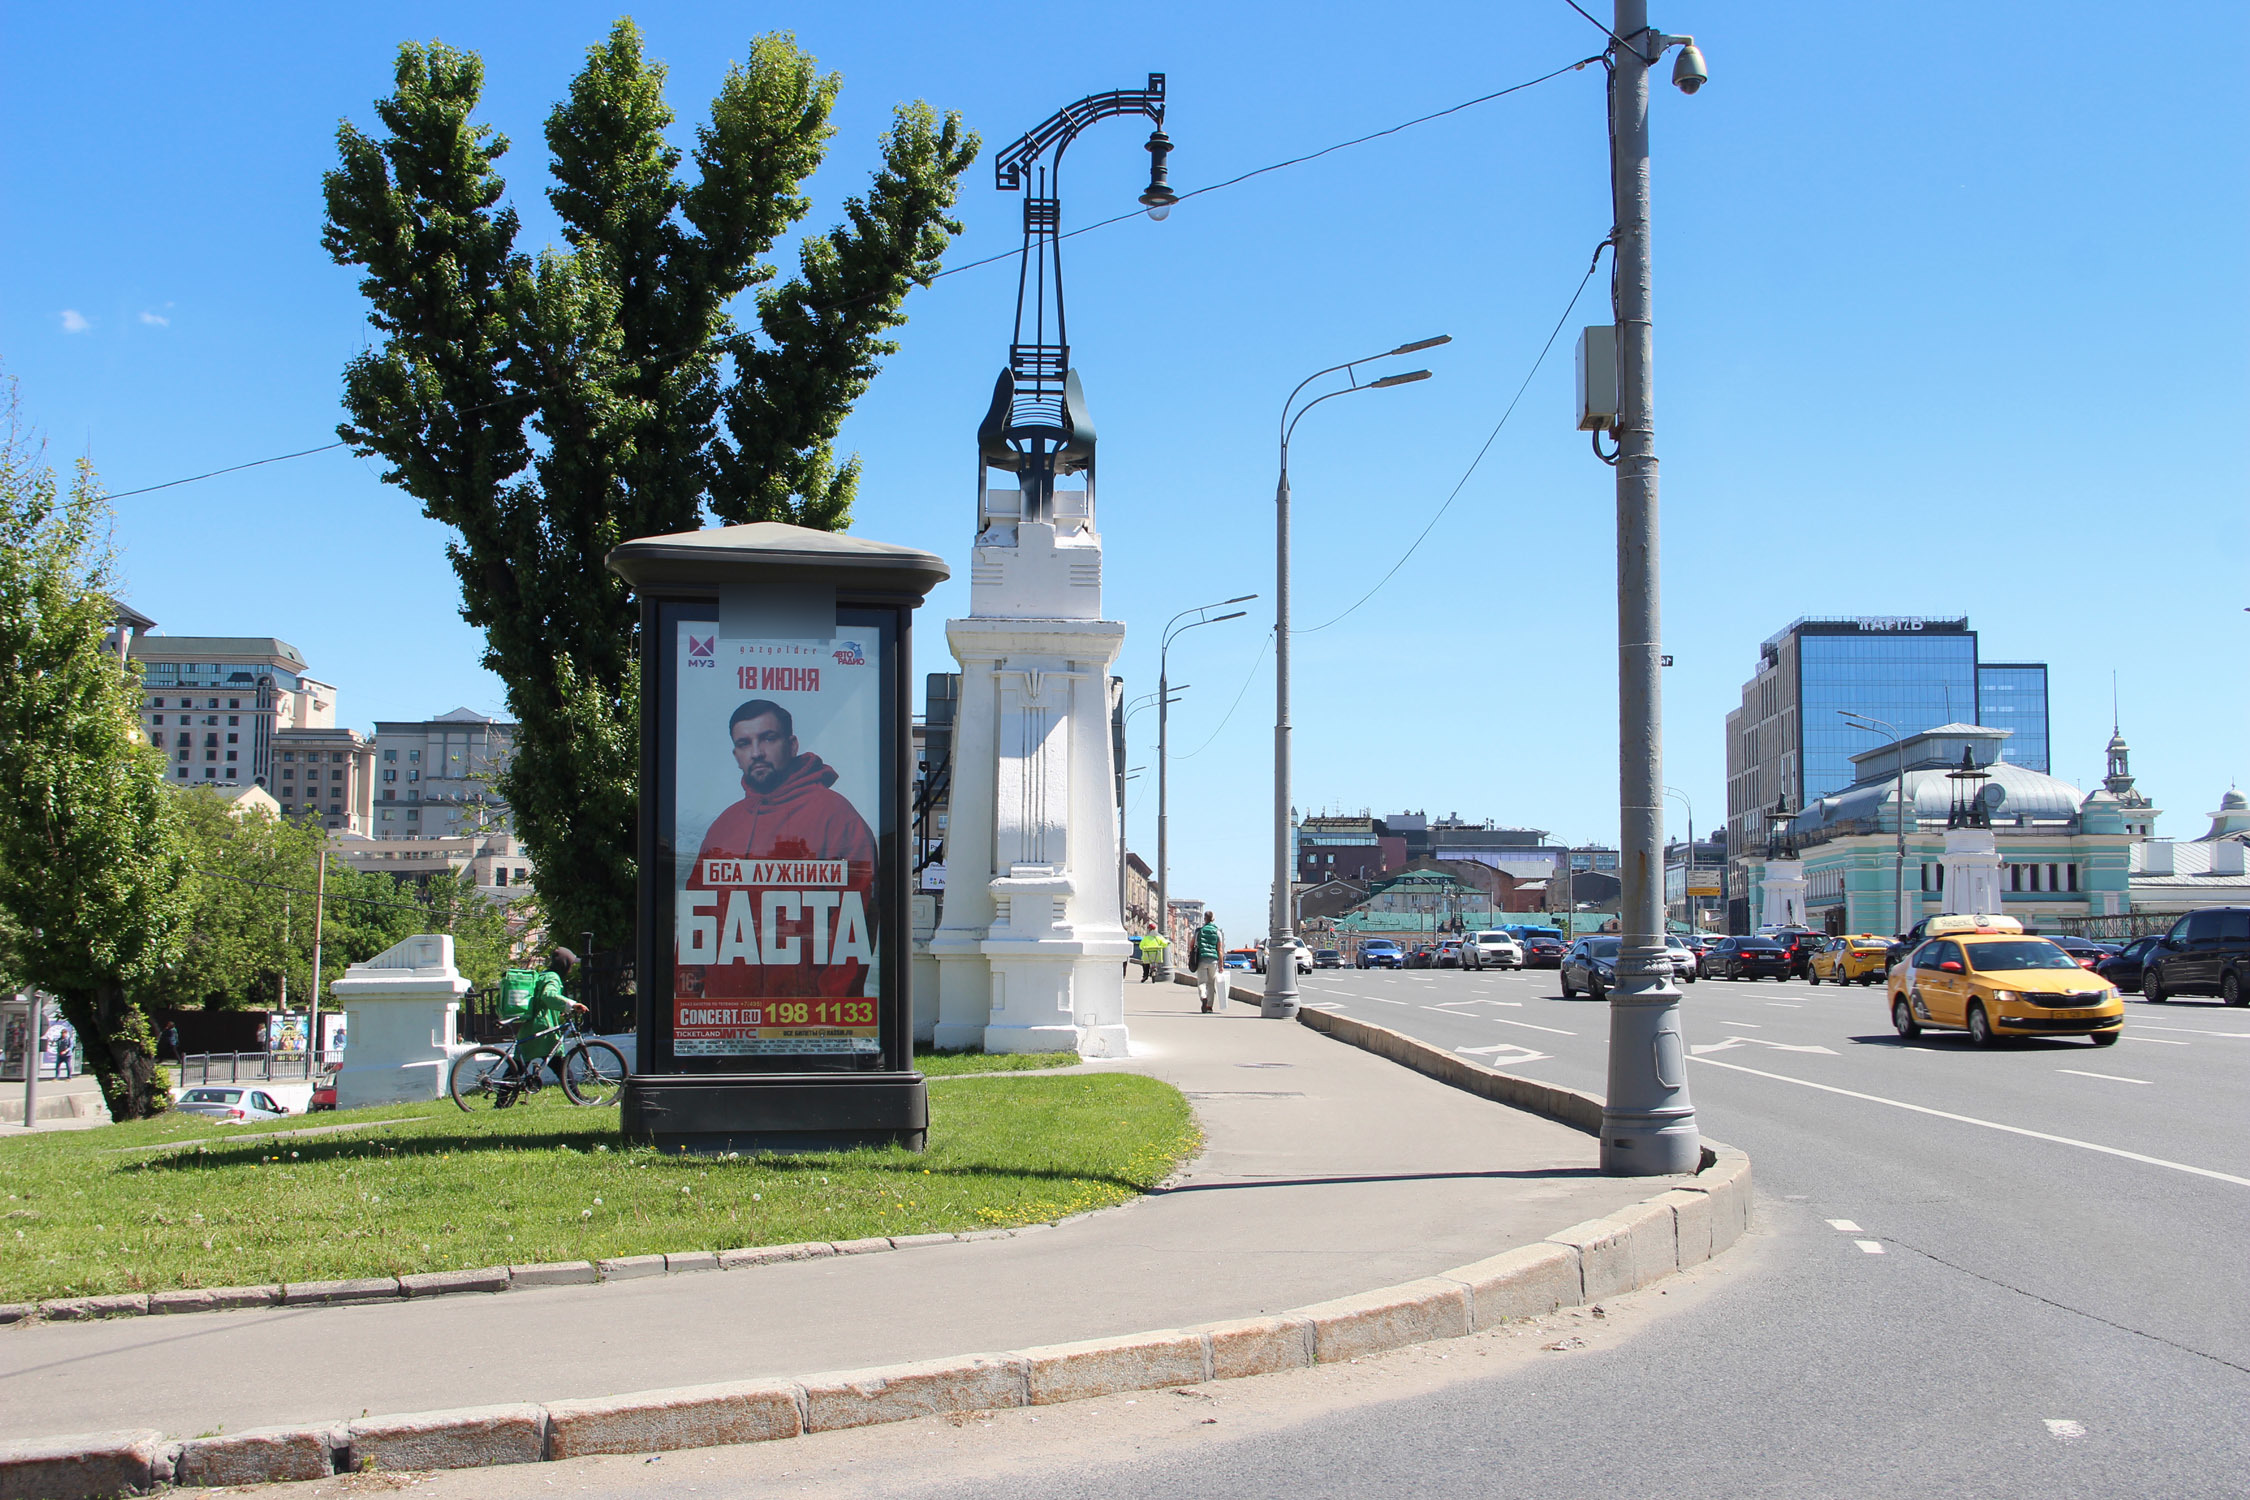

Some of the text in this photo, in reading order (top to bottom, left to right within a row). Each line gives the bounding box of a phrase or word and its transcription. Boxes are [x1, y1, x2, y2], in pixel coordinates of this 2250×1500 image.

[739, 644, 817, 655] gazgolder
[831, 650, 854, 658] АВТО
[688, 659, 715, 668] МУЗ
[837, 657, 865, 665] РАДИО
[737, 666, 820, 692] 18 ИЮНЯ
[709, 862, 842, 884] БСА ЛУЖНИКИ
[678, 890, 872, 965] БАСТА
[679, 972, 700, 992] 16+
[765, 1002, 873, 1024] 198 1133
